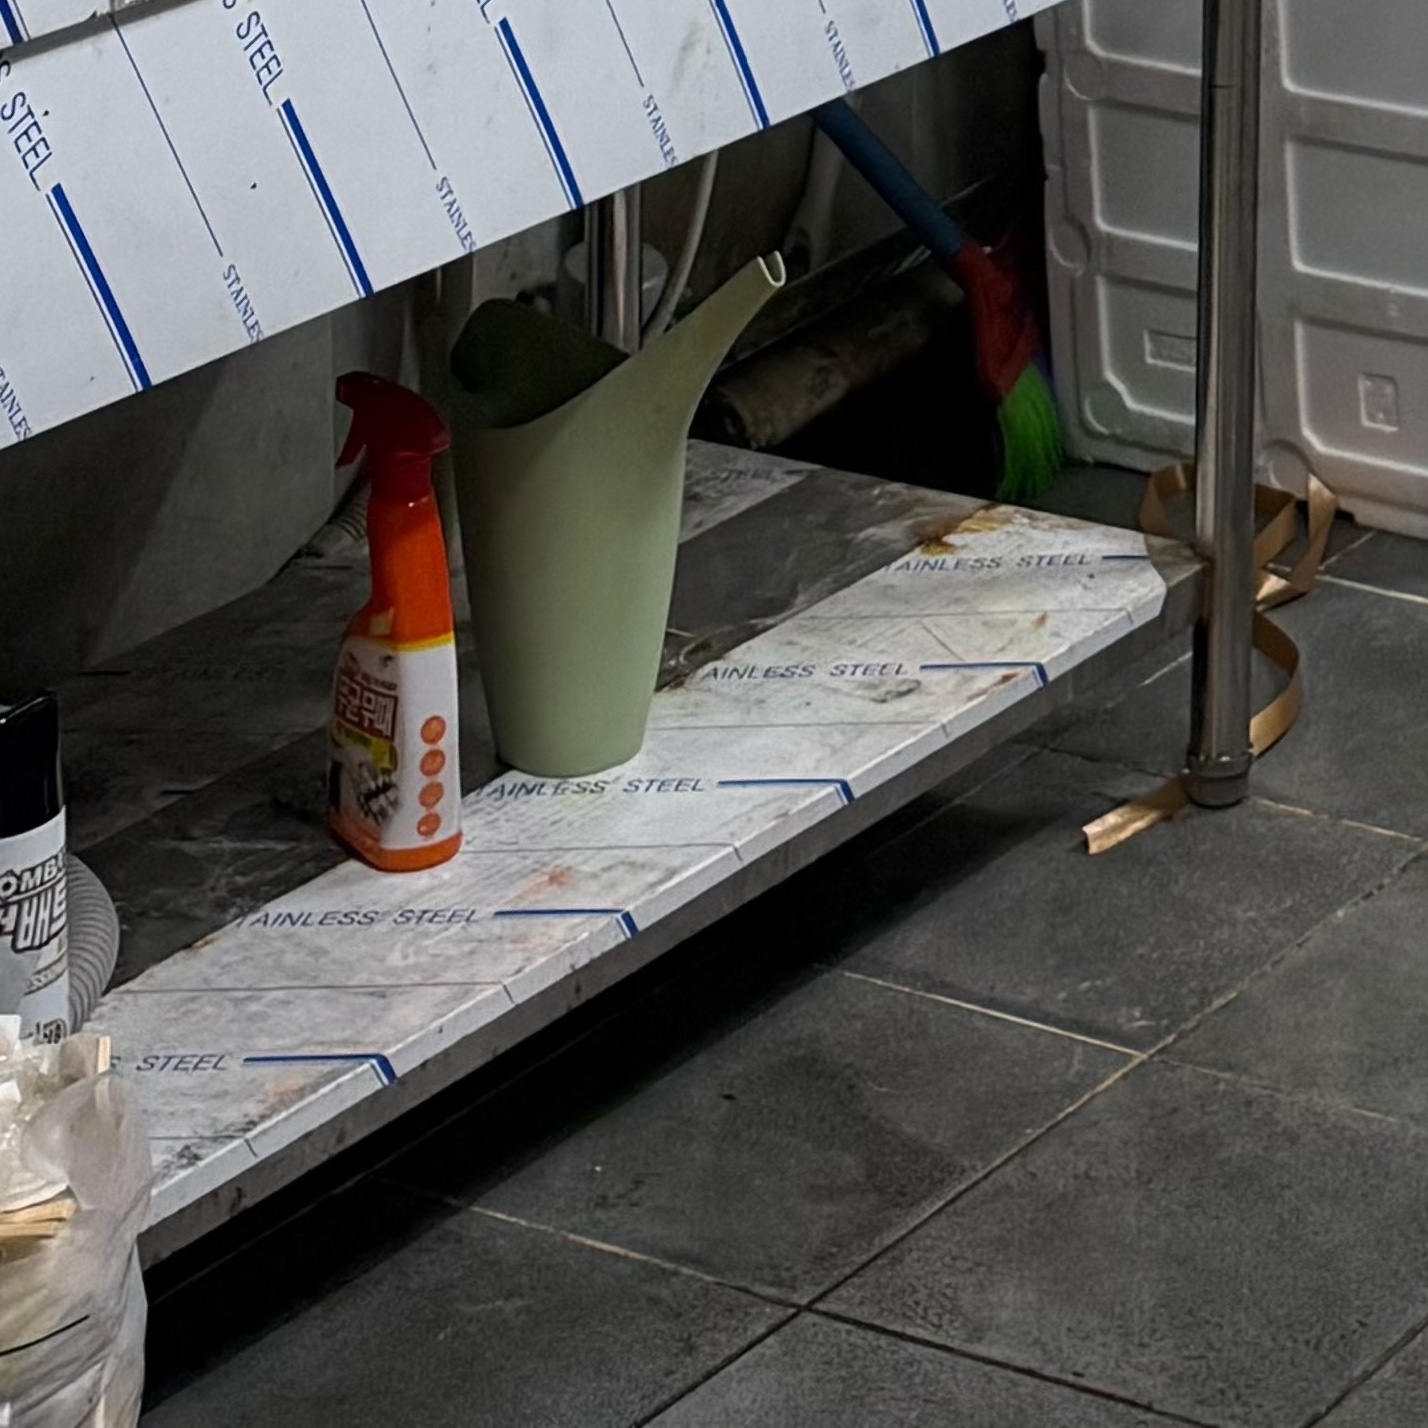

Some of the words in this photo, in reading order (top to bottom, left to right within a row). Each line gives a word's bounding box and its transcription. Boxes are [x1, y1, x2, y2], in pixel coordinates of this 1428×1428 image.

[236, 10, 285, 106] STEEL
[825, 20, 856, 95] STAINLES
[0, 91, 54, 192] STEEL
[643, 93, 679, 170] STAINLES
[436, 175, 478, 254] STAINLES
[222, 263, 265, 345] STAINLES
[1015, 551, 1093, 568] STEEL
[701, 662, 817, 681] AINLESS
[829, 661, 908, 678] STEEL
[621, 776, 709, 795] STEEL
[391, 906, 482, 928] STEEL
[135, 1052, 231, 1073] STEEL
